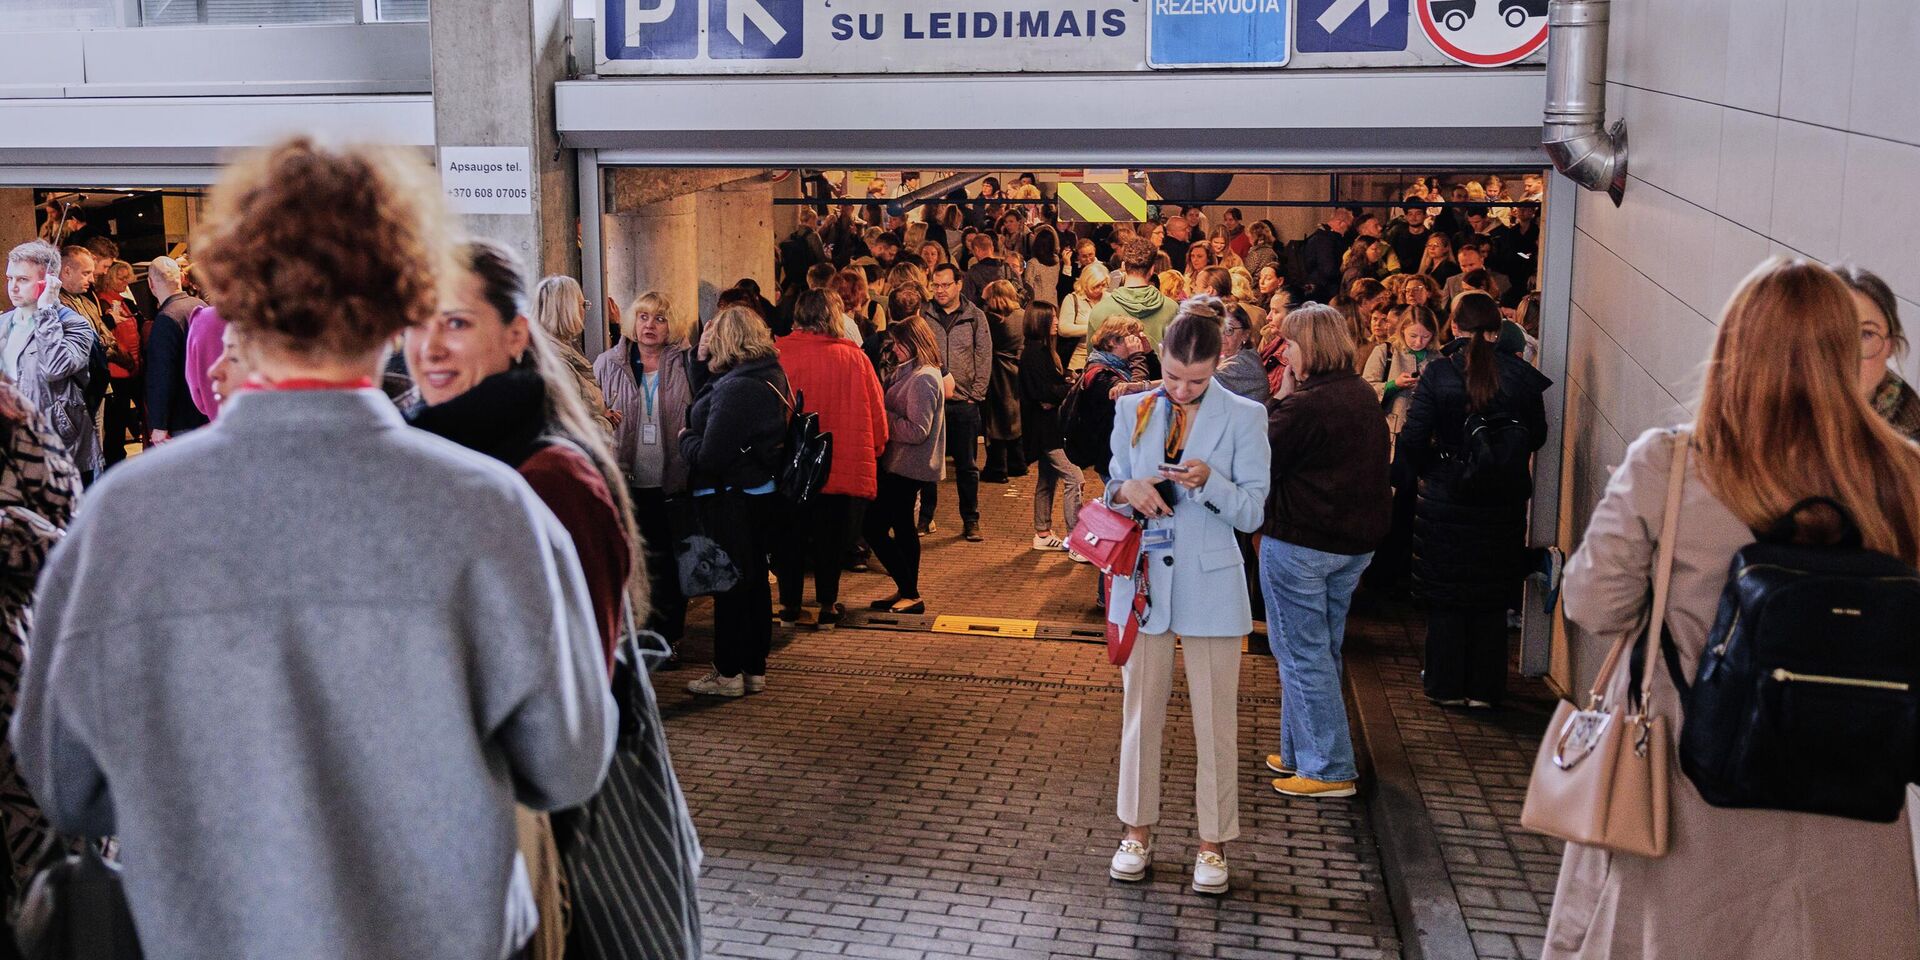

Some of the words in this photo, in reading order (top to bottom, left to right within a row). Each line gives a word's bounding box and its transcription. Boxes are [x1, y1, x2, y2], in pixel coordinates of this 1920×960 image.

[1155, 0, 1280, 15] REZERVUOTA
[624, 0, 677, 48] P
[831, 13, 884, 41] SU
[903, 8, 1127, 40] LEIDIMAIS
[449, 161, 503, 174] Apsaugos
[506, 161, 523, 172] tel.
[448, 188, 472, 198] +370
[474, 188, 493, 198] 608
[496, 188, 527, 198] 07005
